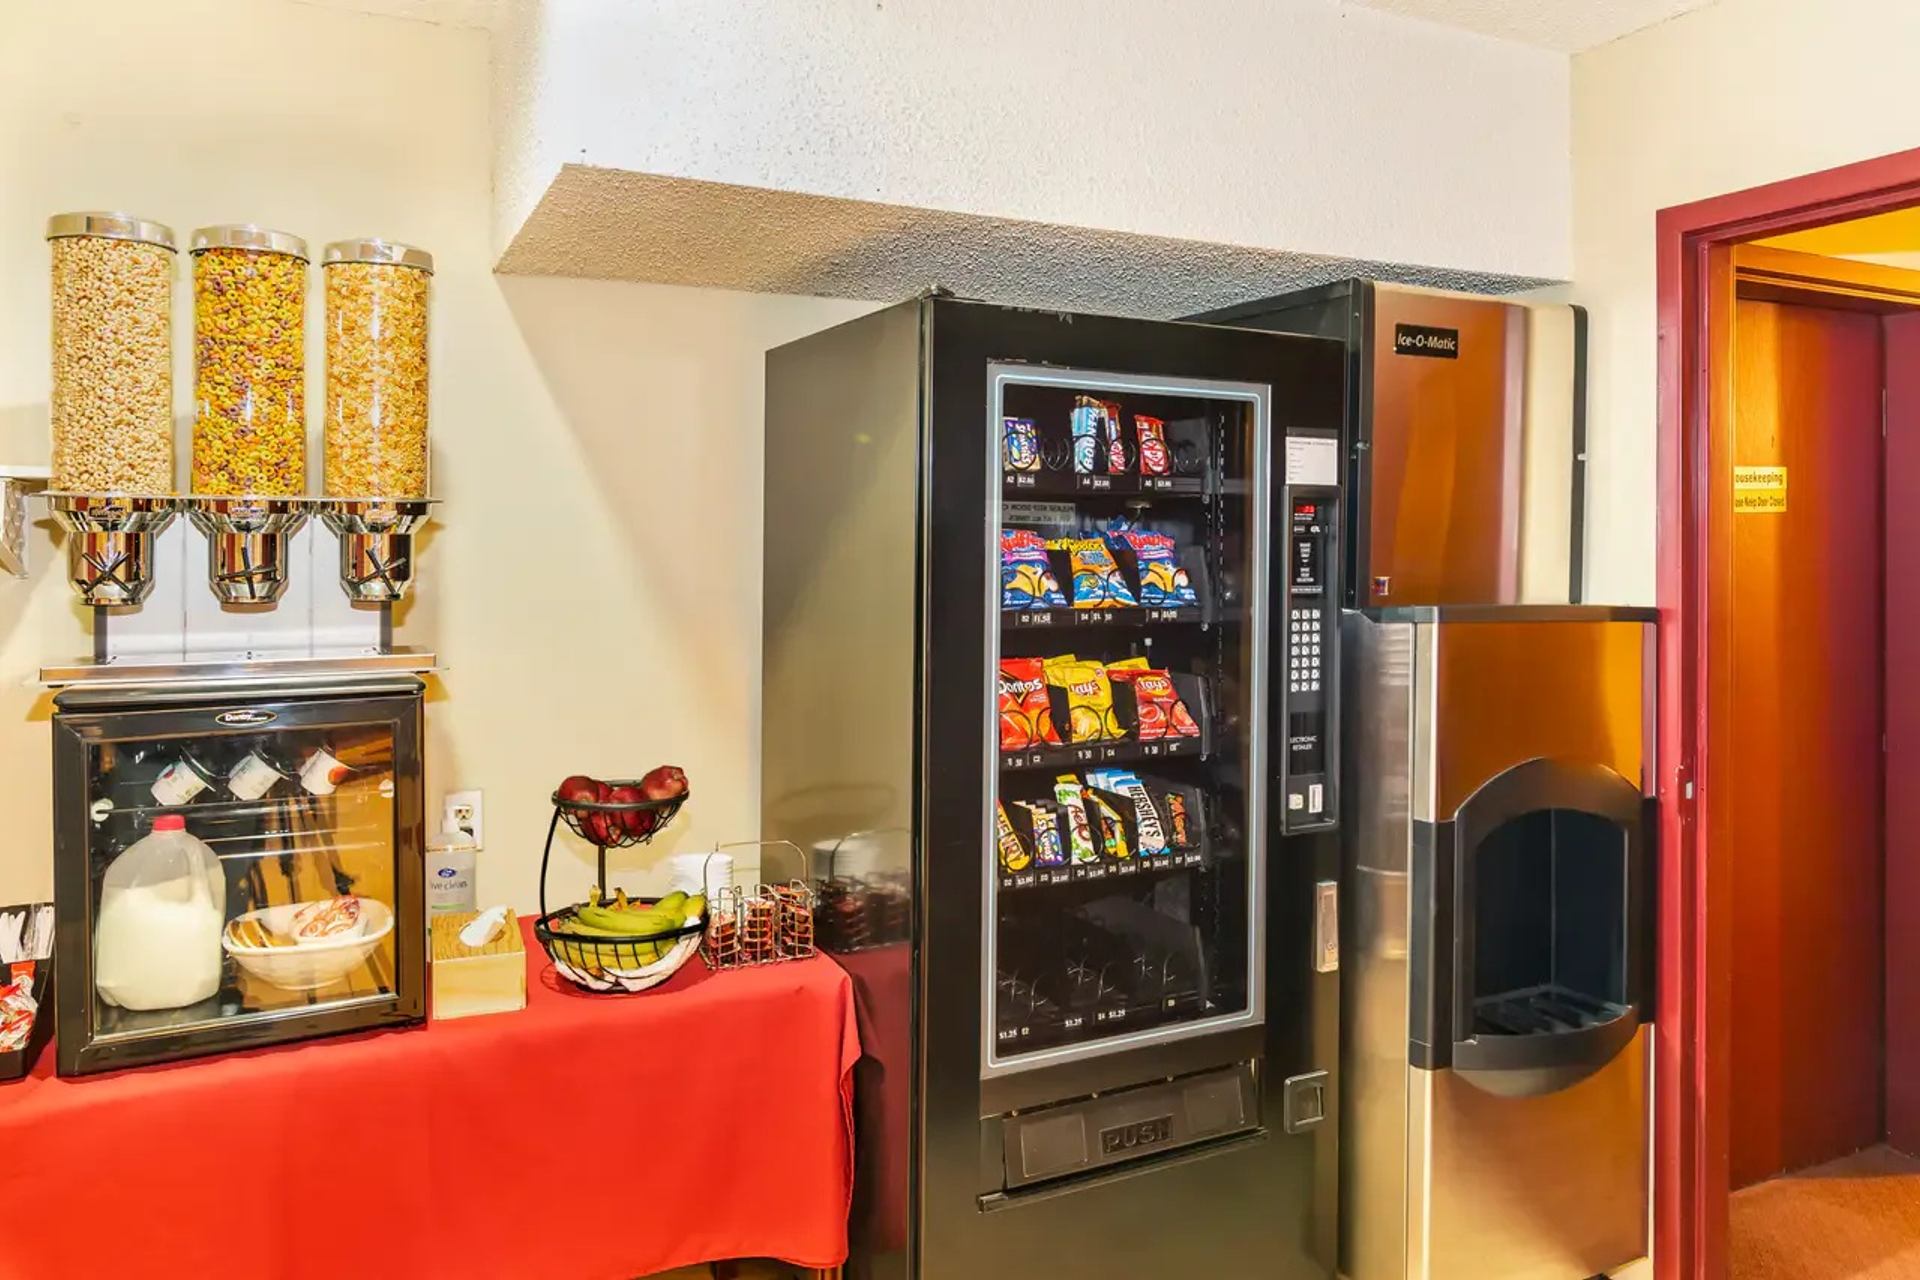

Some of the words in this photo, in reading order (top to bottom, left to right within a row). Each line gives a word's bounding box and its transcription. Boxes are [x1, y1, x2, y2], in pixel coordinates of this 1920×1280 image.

[1397, 333, 1456, 351] Ice-O-Matic
[1735, 471, 1783, 486] ousekeeping
[999, 679, 1043, 695] Doritos
[1105, 1124, 1173, 1149] PUSH
